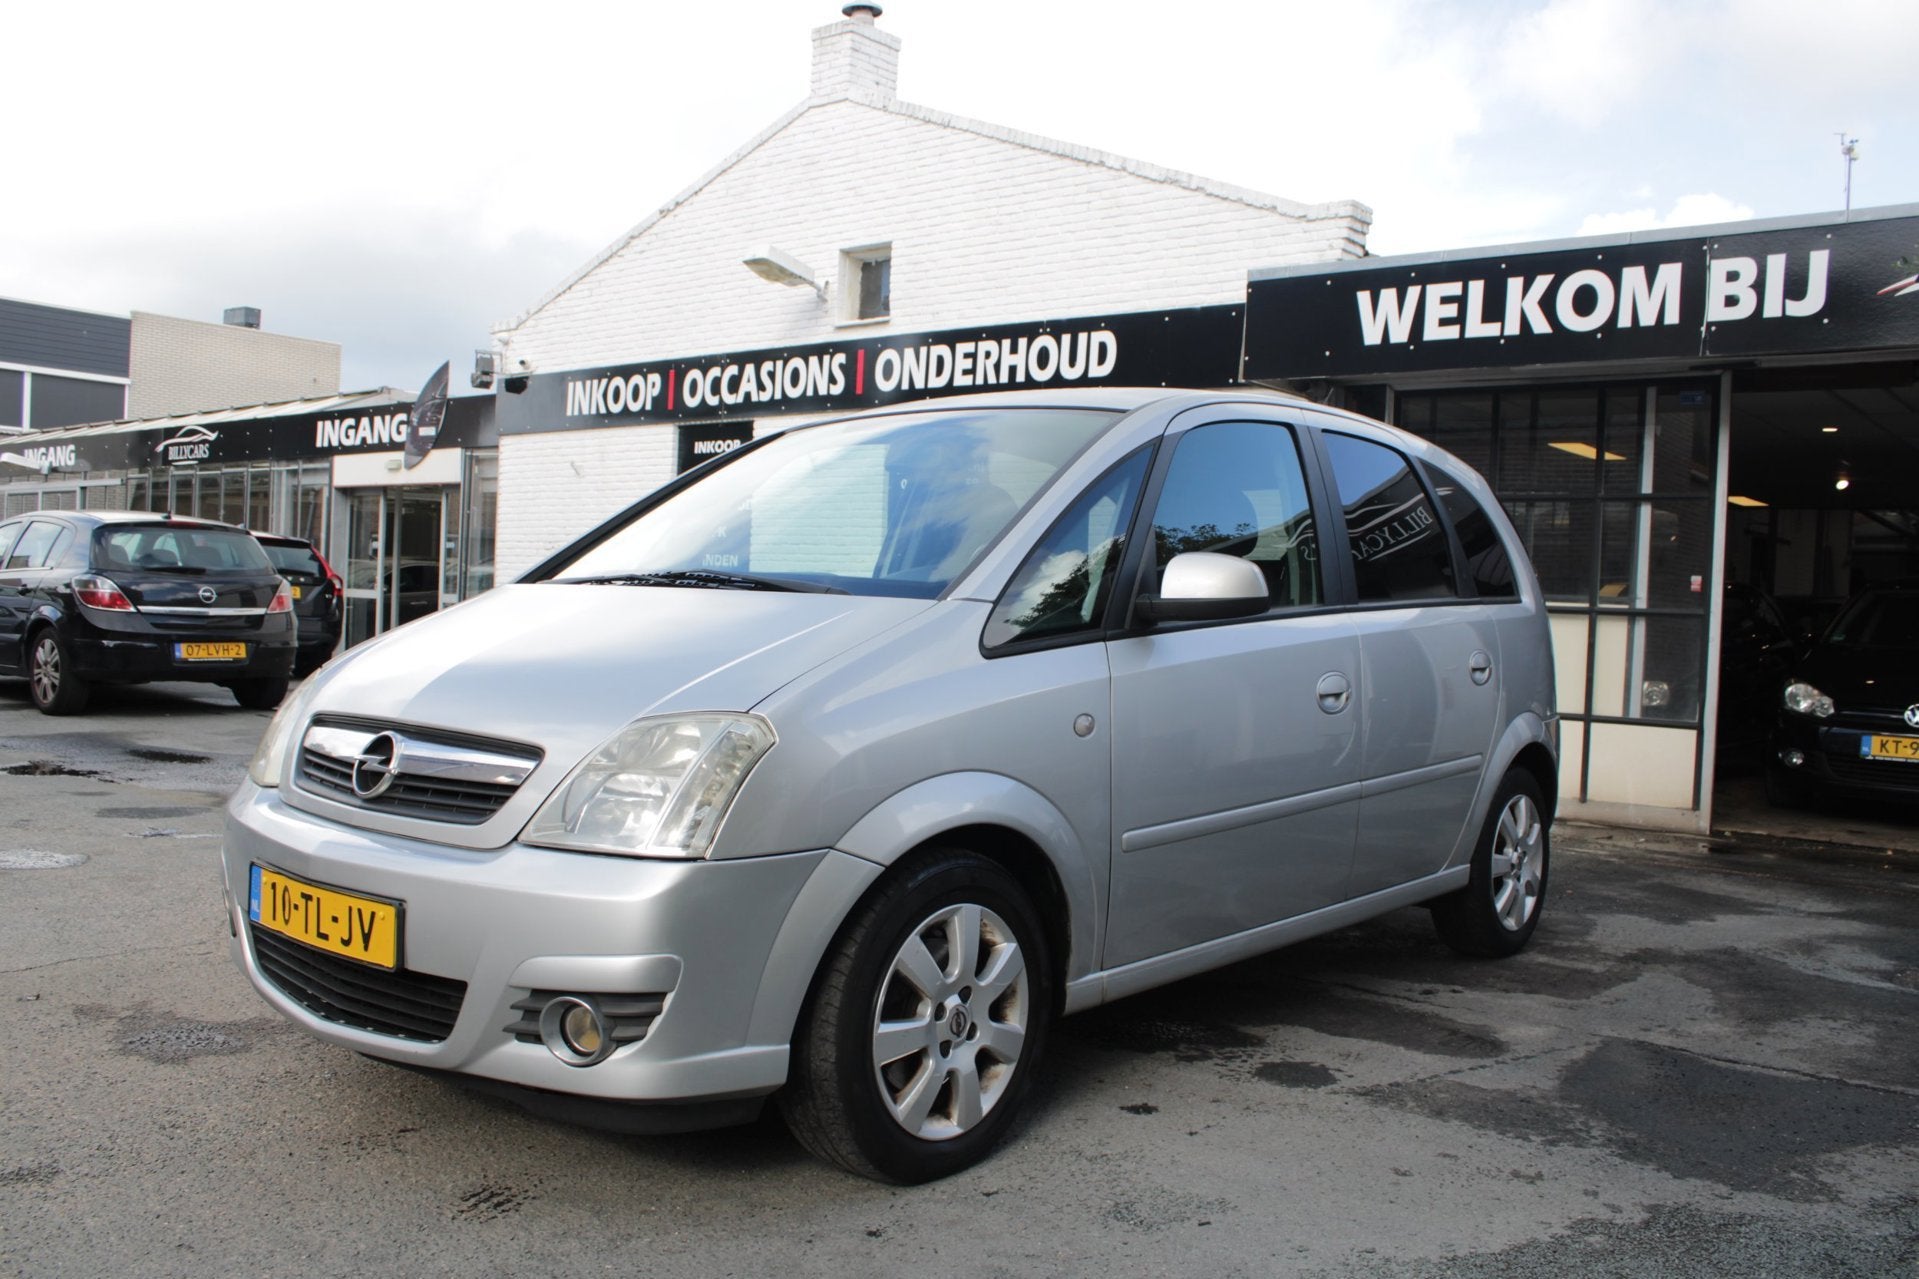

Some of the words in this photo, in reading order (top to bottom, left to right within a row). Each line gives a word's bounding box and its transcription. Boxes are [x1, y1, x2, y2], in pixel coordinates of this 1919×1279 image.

[1356, 262, 1683, 347] WELKOM
[1706, 249, 1831, 322] BIJ
[566, 372, 662, 417] INKOOP
[682, 352, 847, 408] OCCASIONS
[874, 329, 1118, 393] ONDERHOUD
[315, 412, 409, 448] INGANG
[168, 444, 210, 460] BILLYCARS
[694, 439, 741, 454] INKOOP
[186, 644, 242, 656] 07-LVH-2
[1880, 739, 1919, 756] KT-9
[271, 881, 376, 952] 10-TL-JV
